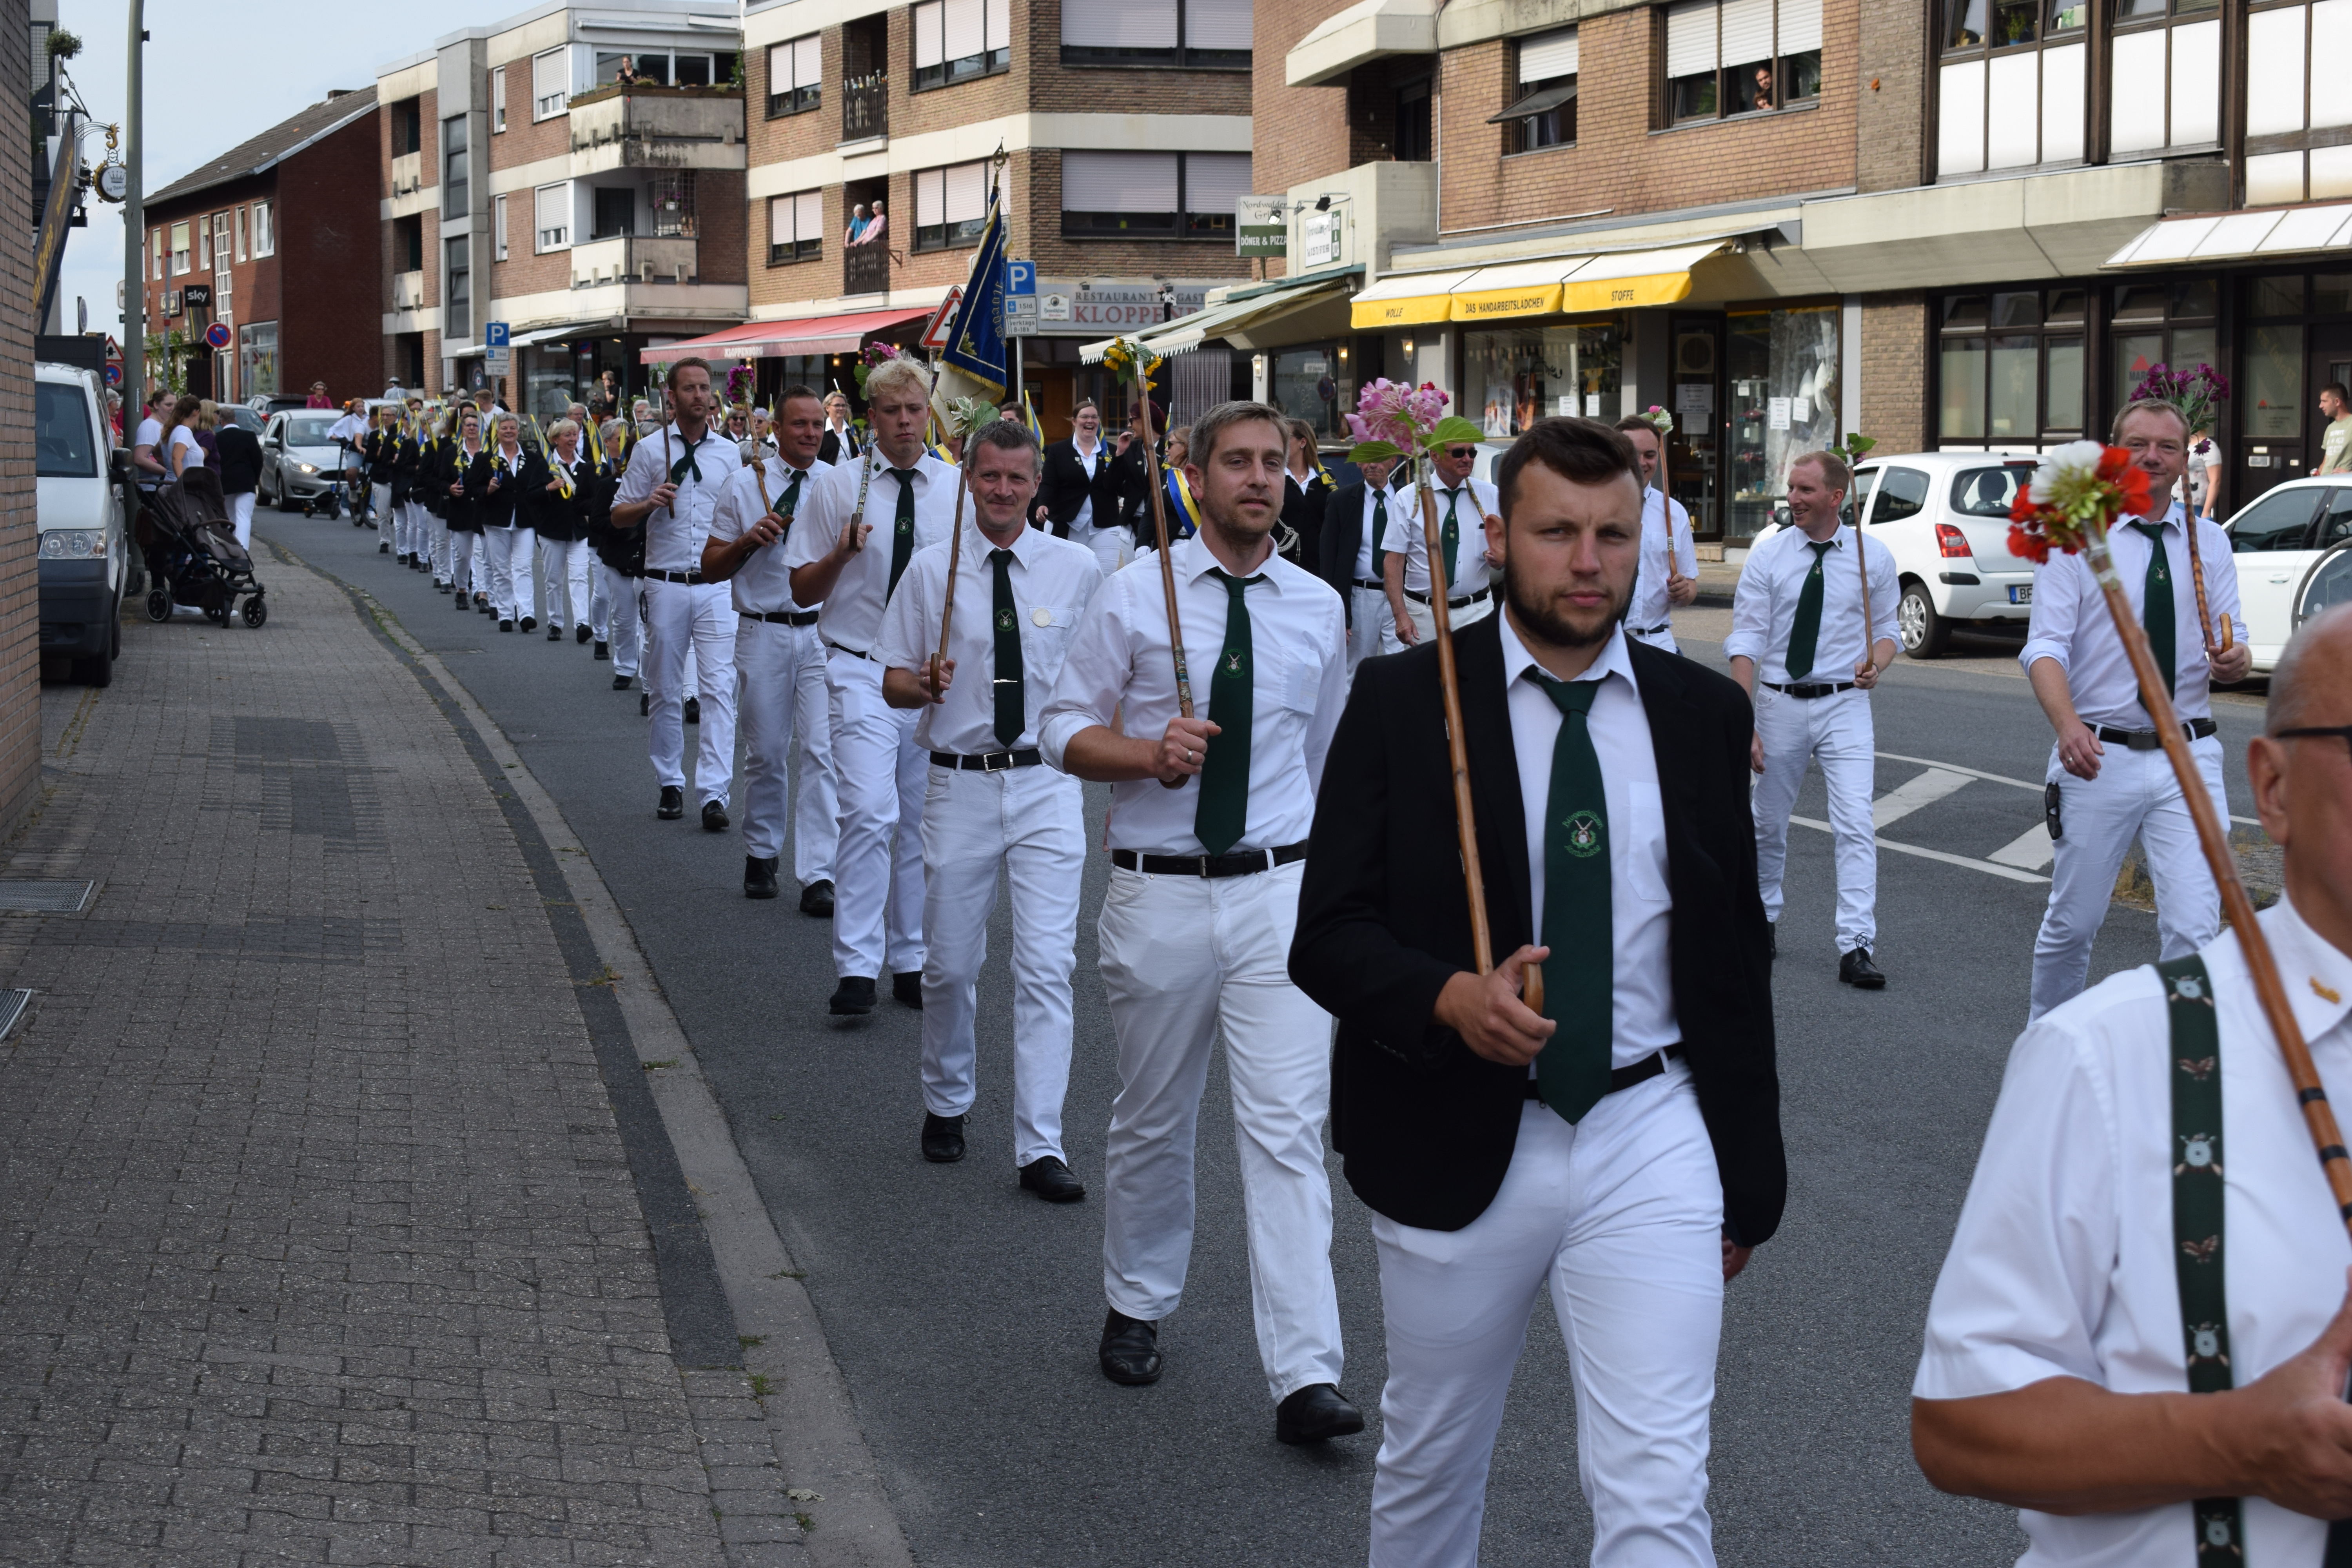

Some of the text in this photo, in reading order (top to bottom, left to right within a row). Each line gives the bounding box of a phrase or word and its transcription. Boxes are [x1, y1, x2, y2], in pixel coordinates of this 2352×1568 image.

[1241, 200, 1287, 210] Nordwalder
[1241, 235, 1287, 246] DÖNER & PIZZA
[1010, 266, 1028, 291] P
[188, 290, 208, 302] sky
[1075, 292, 1205, 302] RESTAURANT GAST
[1612, 289, 1634, 301] STOFFE
[1466, 296, 1544, 314] DAS HANDARBEITSLÄDCHEN
[1385, 307, 1403, 318] WOLLE
[491, 325, 505, 343] P
